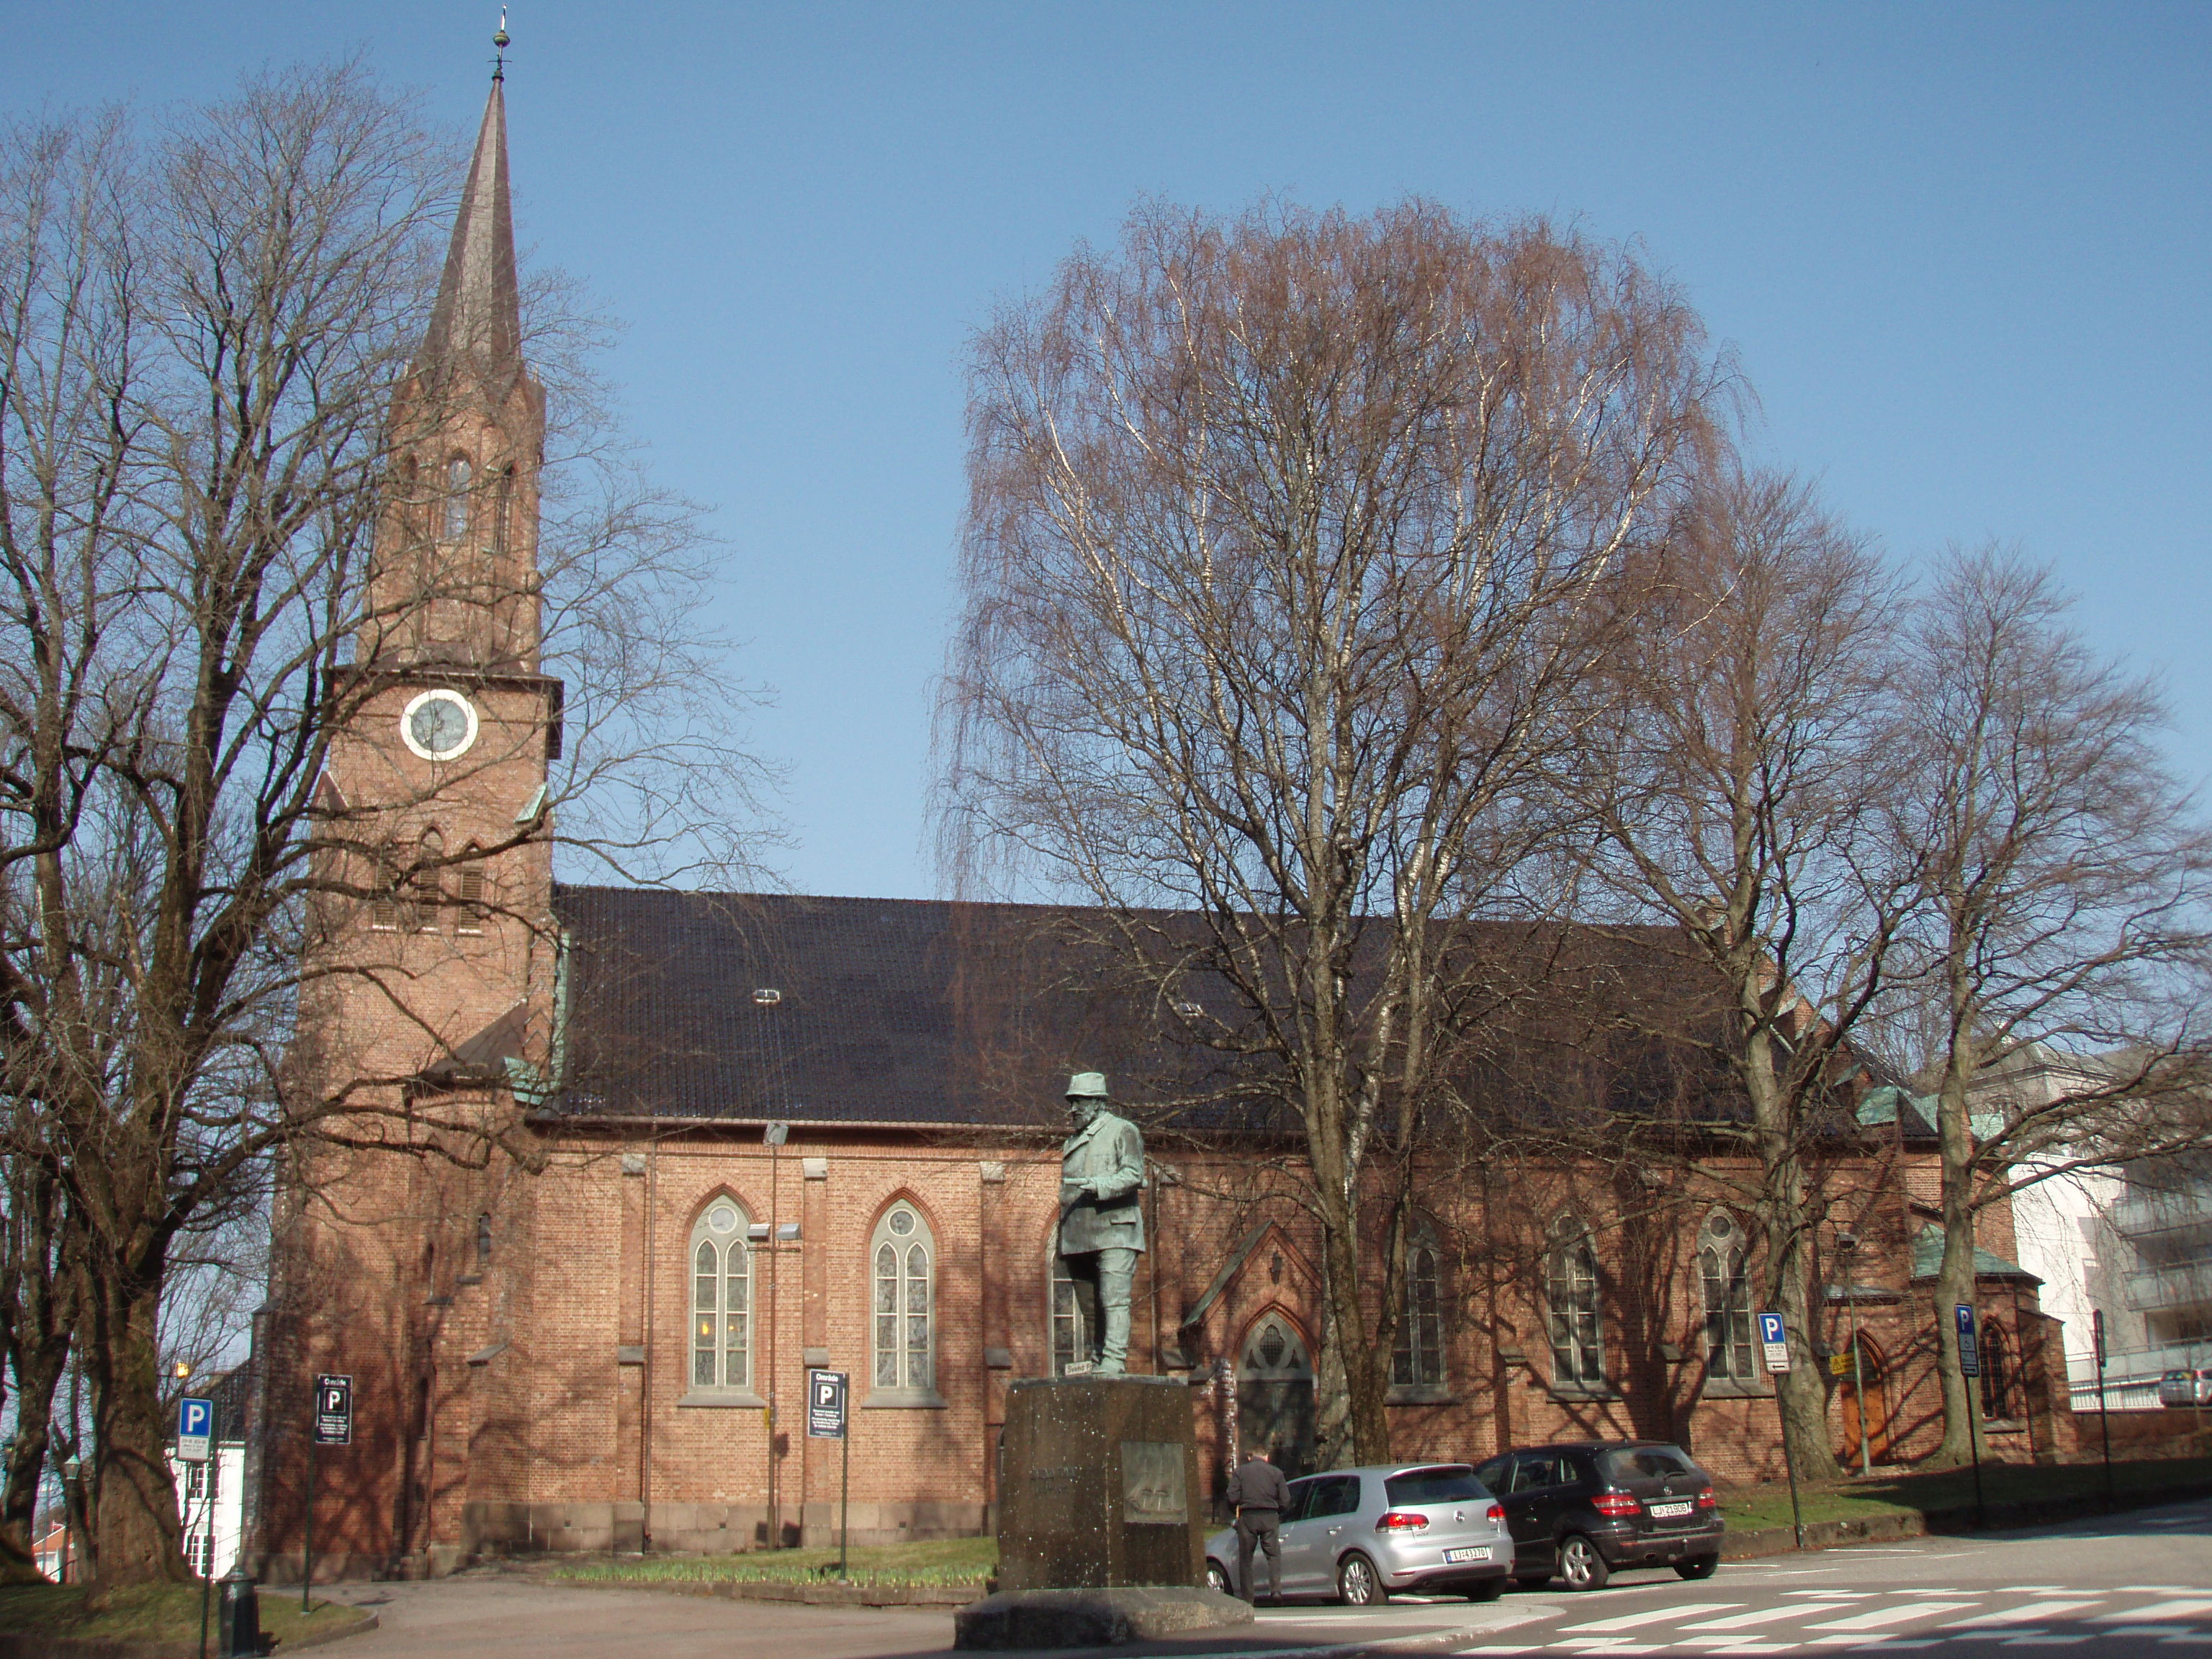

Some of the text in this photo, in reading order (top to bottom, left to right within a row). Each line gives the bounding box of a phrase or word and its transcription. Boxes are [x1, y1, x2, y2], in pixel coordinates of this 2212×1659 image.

[1765, 1318, 1779, 1340] P
[1959, 1310, 1969, 1331] P
[328, 1390, 341, 1410] P
[820, 1385, 833, 1405] P
[188, 1404, 205, 1432] P
